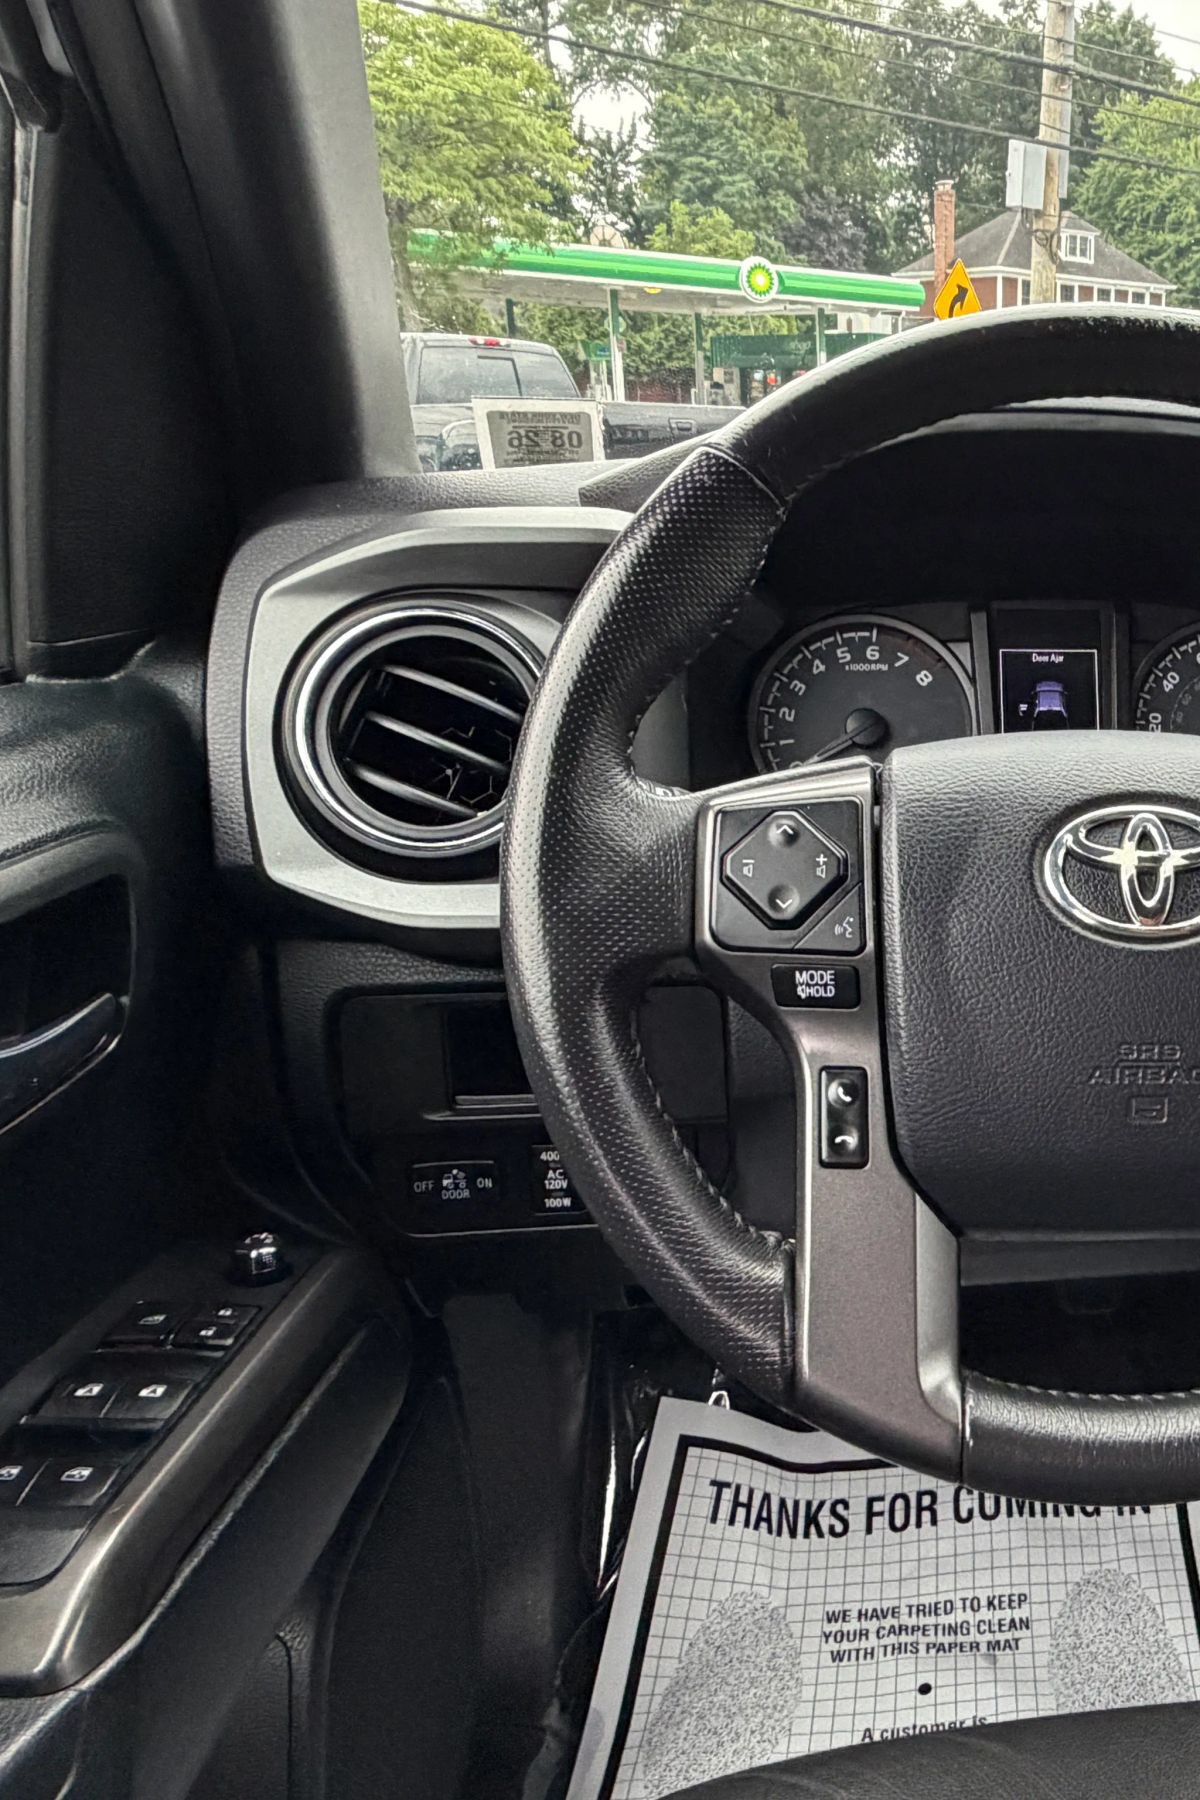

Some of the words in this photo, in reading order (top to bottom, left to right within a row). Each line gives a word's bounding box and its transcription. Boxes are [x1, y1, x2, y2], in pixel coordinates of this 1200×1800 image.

[836, 646, 852, 663] 5
[865, 645, 880, 661] 6
[893, 652, 910, 667] 7
[1050, 653, 1065, 664] Ajar
[812, 659, 826, 675] 4
[915, 670, 934, 687] 8
[1161, 671, 1181, 694] 40
[789, 679, 807, 696] 3
[779, 707, 796, 722] 2
[1149, 712, 1162, 734] 20
[795, 970, 836, 985] MODE
[806, 986, 836, 998] HOLD
[546, 1169, 565, 1180] AC
[413, 1180, 435, 1193] OFF
[476, 1178, 493, 1189] ON
[544, 1179, 569, 1190] 120V
[441, 1189, 471, 1200] DOOR
[543, 1197, 572, 1208] 100W
[708, 1479, 851, 1540] THANKS
[865, 1489, 938, 1536] FOR
[826, 1609, 852, 1624] WE
[857, 1606, 901, 1622] HAVE
[905, 1599, 954, 1618] TRIED
[959, 1596, 981, 1613] TO
[987, 1593, 1028, 1611] KEEP
[823, 1628, 870, 1645] YOUR
[875, 1620, 971, 1640] CARPETING
[976, 1616, 1030, 1635] CLEAN
[830, 1647, 875, 1664] WITH
[881, 1641, 920, 1658] THIS
[925, 1641, 980, 1655] PAPER
[986, 1638, 1022, 1653] MAT
[860, 1727, 874, 1742] A
[880, 1720, 966, 1741] customer
